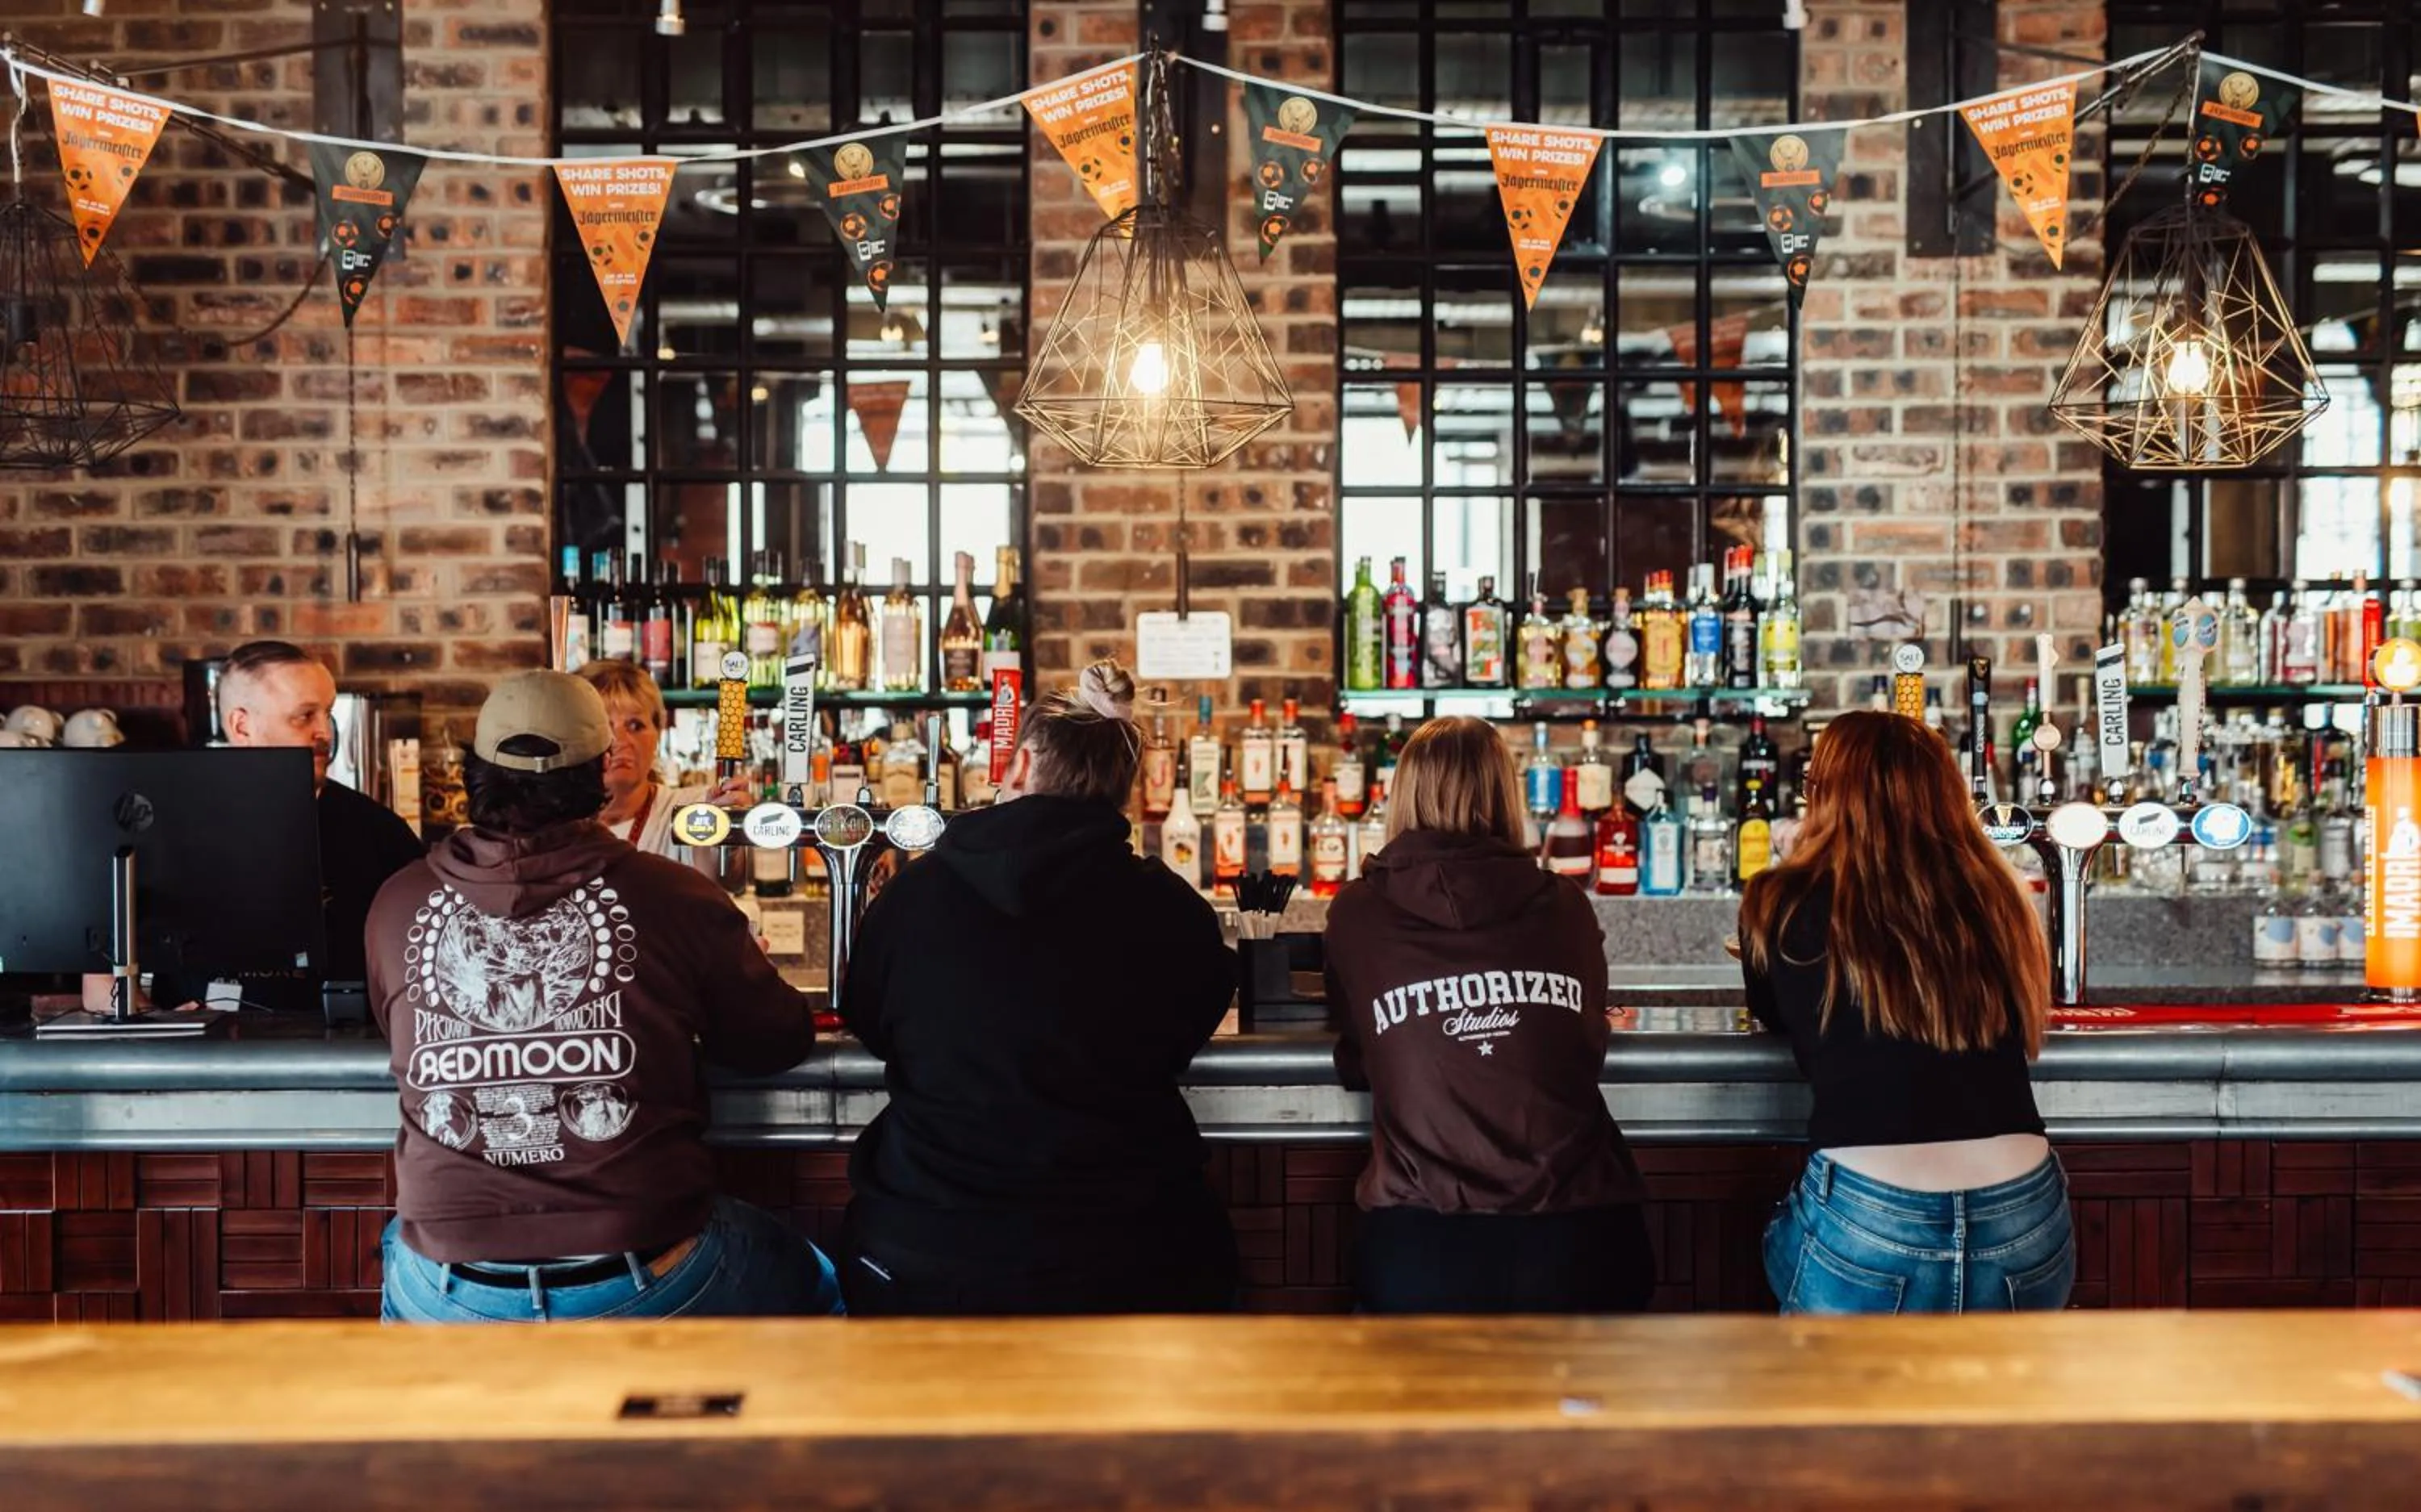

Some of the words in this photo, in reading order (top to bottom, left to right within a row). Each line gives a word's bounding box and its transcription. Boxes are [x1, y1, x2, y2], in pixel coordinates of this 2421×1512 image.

[1031, 86, 1079, 111] SHARE
[1081, 69, 1132, 94] SHOTS,
[53, 85, 106, 107] SHARE
[109, 98, 164, 121] SHOTS,
[60, 102, 92, 120] WIN
[1042, 104, 1073, 123] WIN
[1075, 86, 1129, 114] PRIZES!
[1967, 99, 2018, 121] SHARE
[1978, 117, 2009, 134] WIN
[1491, 131, 1540, 146] SHARE
[1544, 135, 1597, 152] SHOTS,
[1498, 148, 1528, 161] WIN
[561, 168, 612, 181] SHARE
[616, 167, 670, 181] SHOTS,
[570, 184, 600, 196] WIN
[606, 182, 662, 195] PRIZES!
[788, 686, 809, 753] CARLING
[2102, 678, 2124, 746] CARLING
[1373, 971, 1583, 1035] AUTHORIZED
[1443, 1007, 1520, 1036] Studios
[484, 1147, 565, 1167] NUMERO
